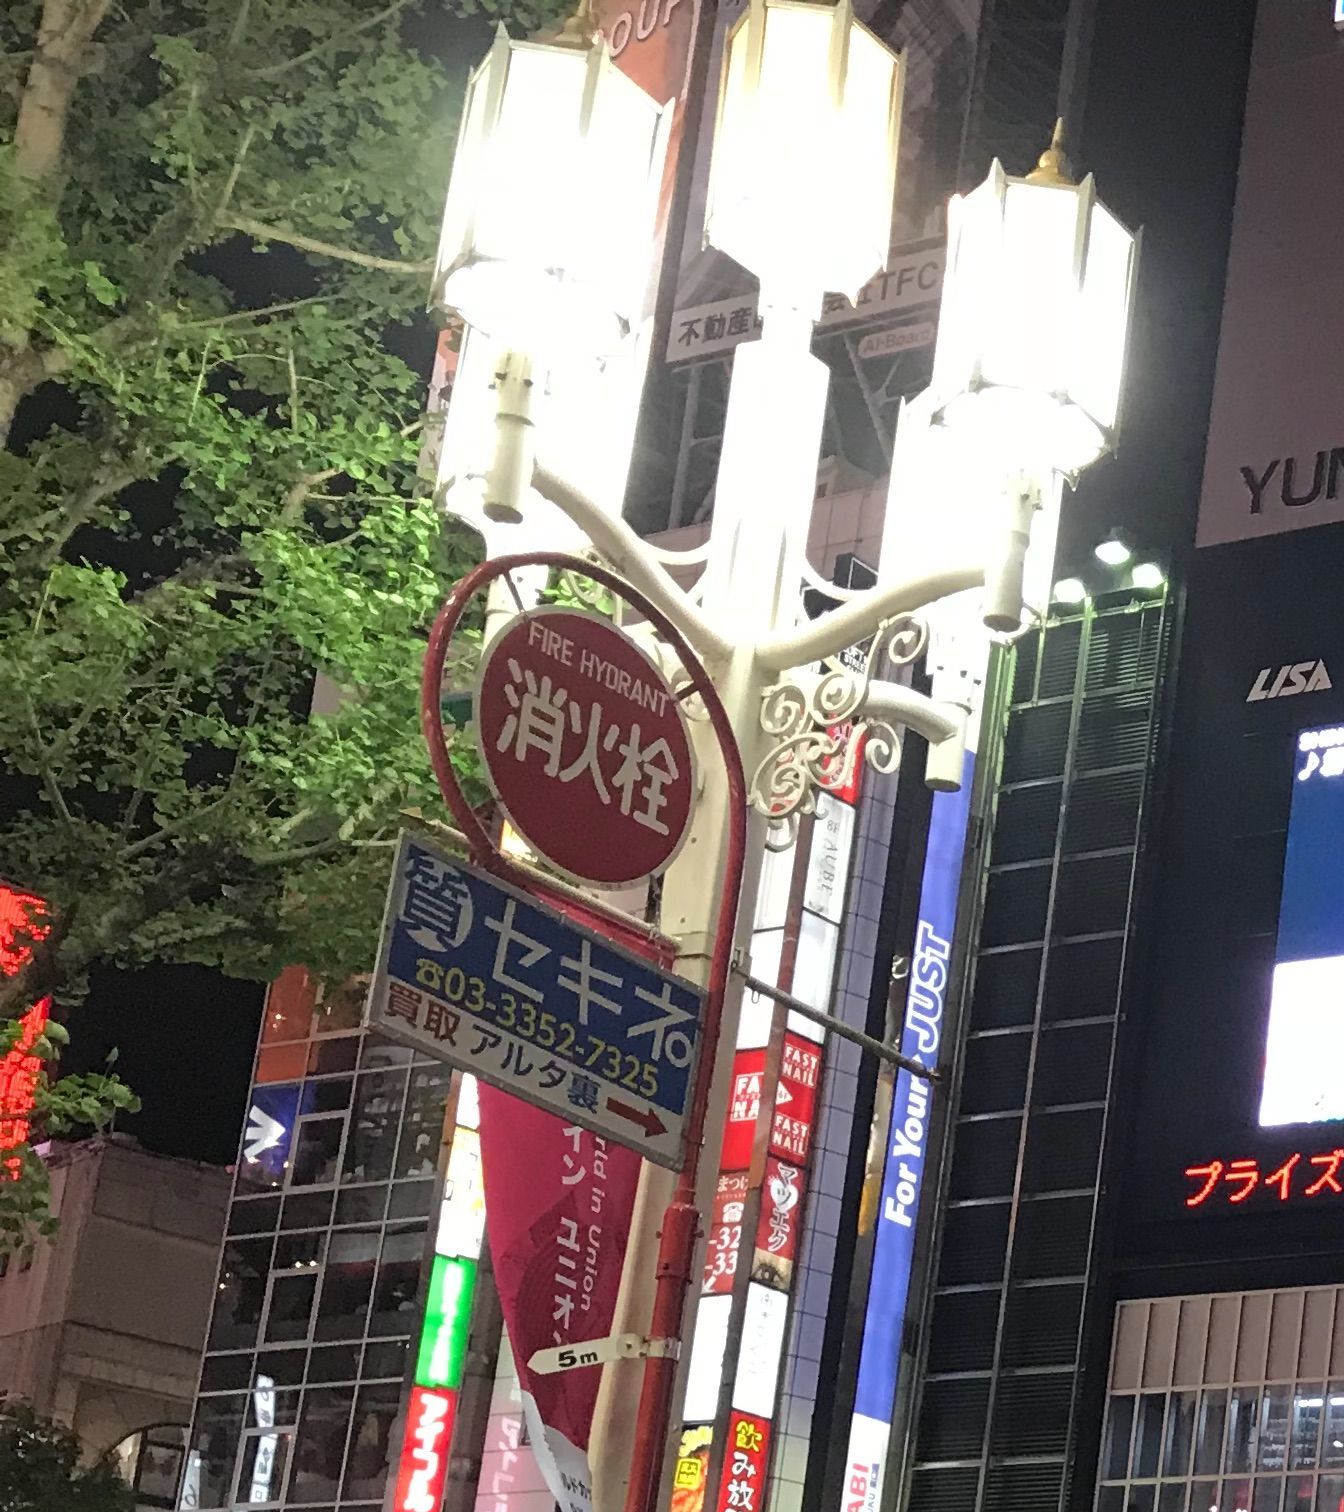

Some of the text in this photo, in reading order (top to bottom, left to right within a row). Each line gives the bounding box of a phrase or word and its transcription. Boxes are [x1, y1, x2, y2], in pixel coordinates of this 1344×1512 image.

[527, 621, 672, 717] FIRE HYDRANT
[497, 656, 680, 839] 消火栓
[484, 899, 697, 1069] セキネ
[384, 981, 602, 1116] 買取 アルタ裏
[444, 966, 660, 1099] 03-3352-7325
[782, 1065, 816, 1088] NAIL
[784, 1046, 818, 1070] FAST
[773, 1134, 806, 1157] NAIL
[776, 1117, 810, 1140] FAST
